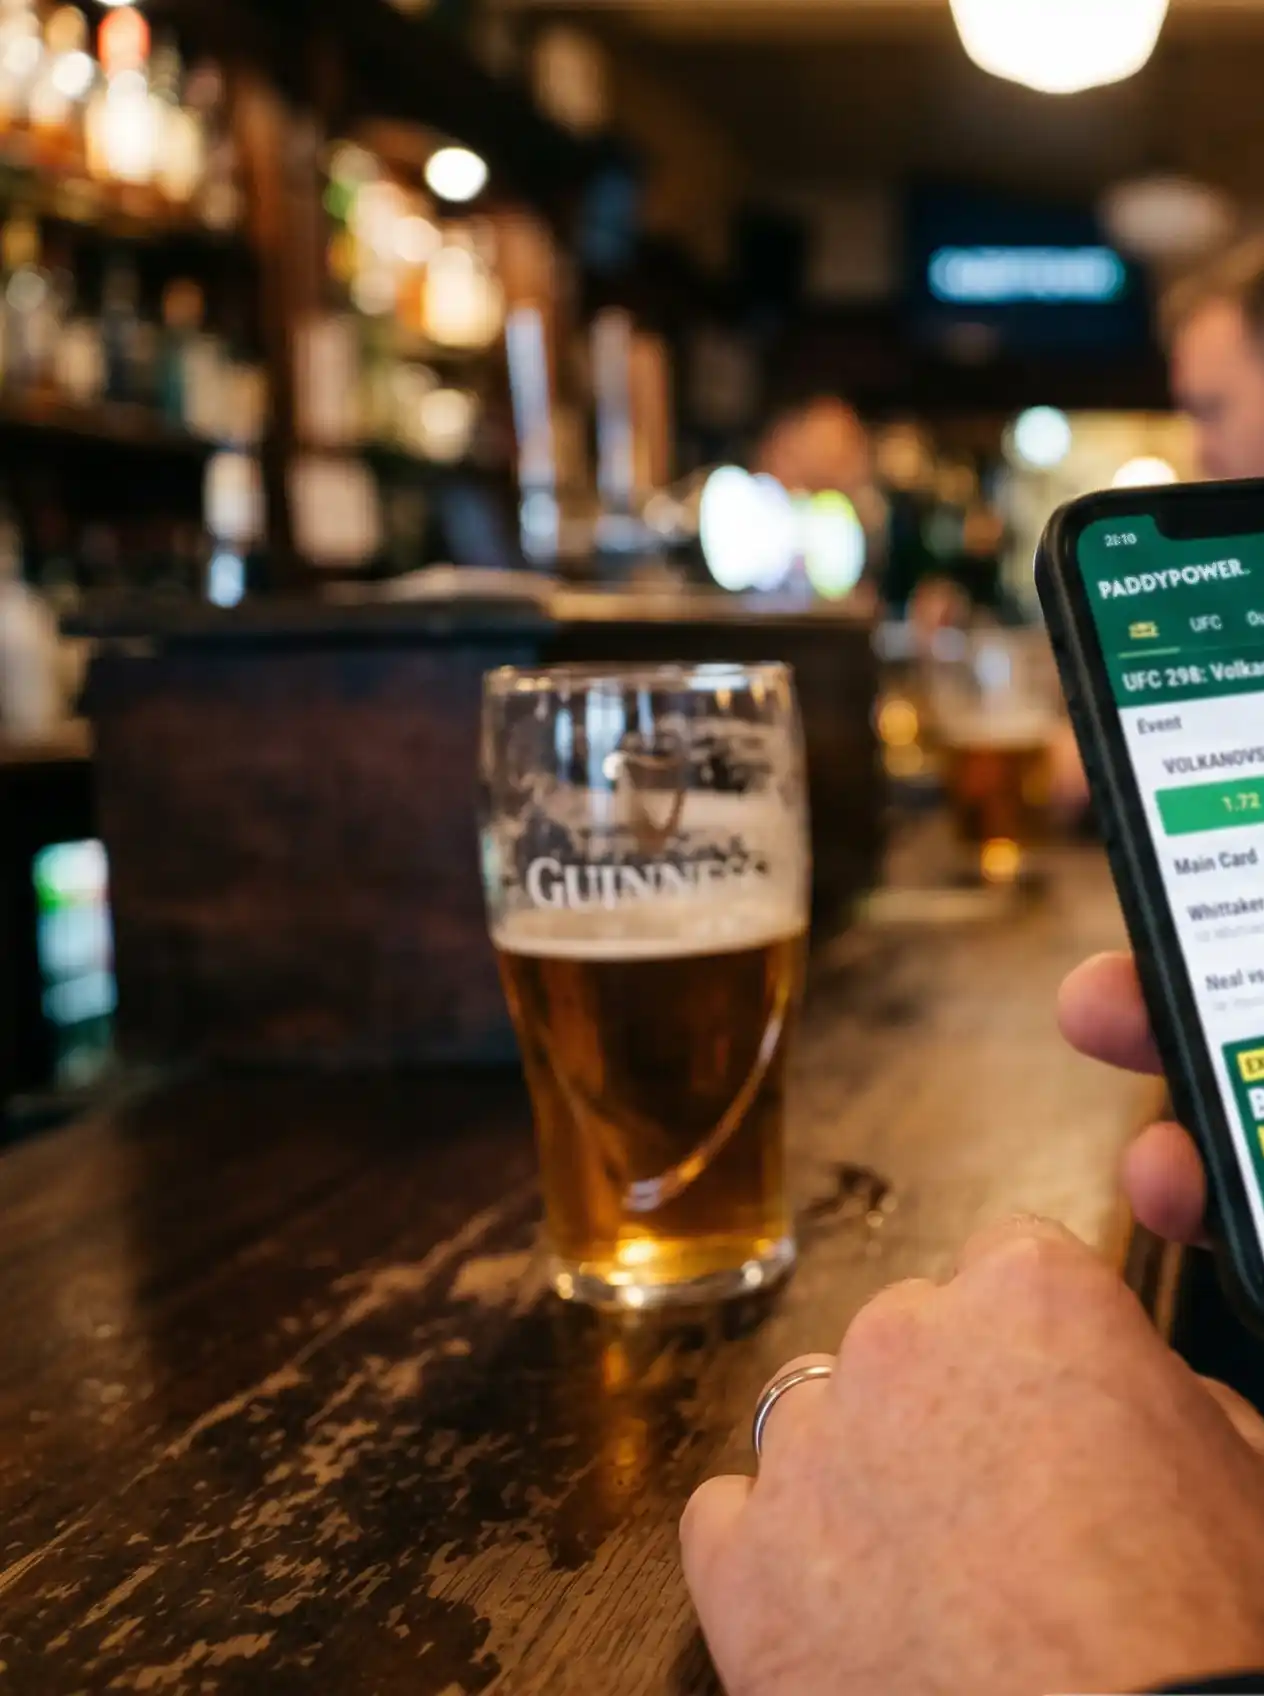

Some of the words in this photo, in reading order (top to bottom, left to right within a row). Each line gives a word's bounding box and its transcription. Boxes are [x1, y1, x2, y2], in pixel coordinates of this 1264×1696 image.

[1189, 614, 1222, 632] UFC
[1122, 669, 1162, 692] UFC
[1164, 665, 1208, 687] 298:
[1137, 715, 1183, 735] Event
[1221, 792, 1262, 812] 1.72
[1173, 857, 1216, 875] Main
[1218, 848, 1258, 868] Card
[1187, 898, 1264, 921] Whittaker
[1205, 968, 1243, 991] Neal
